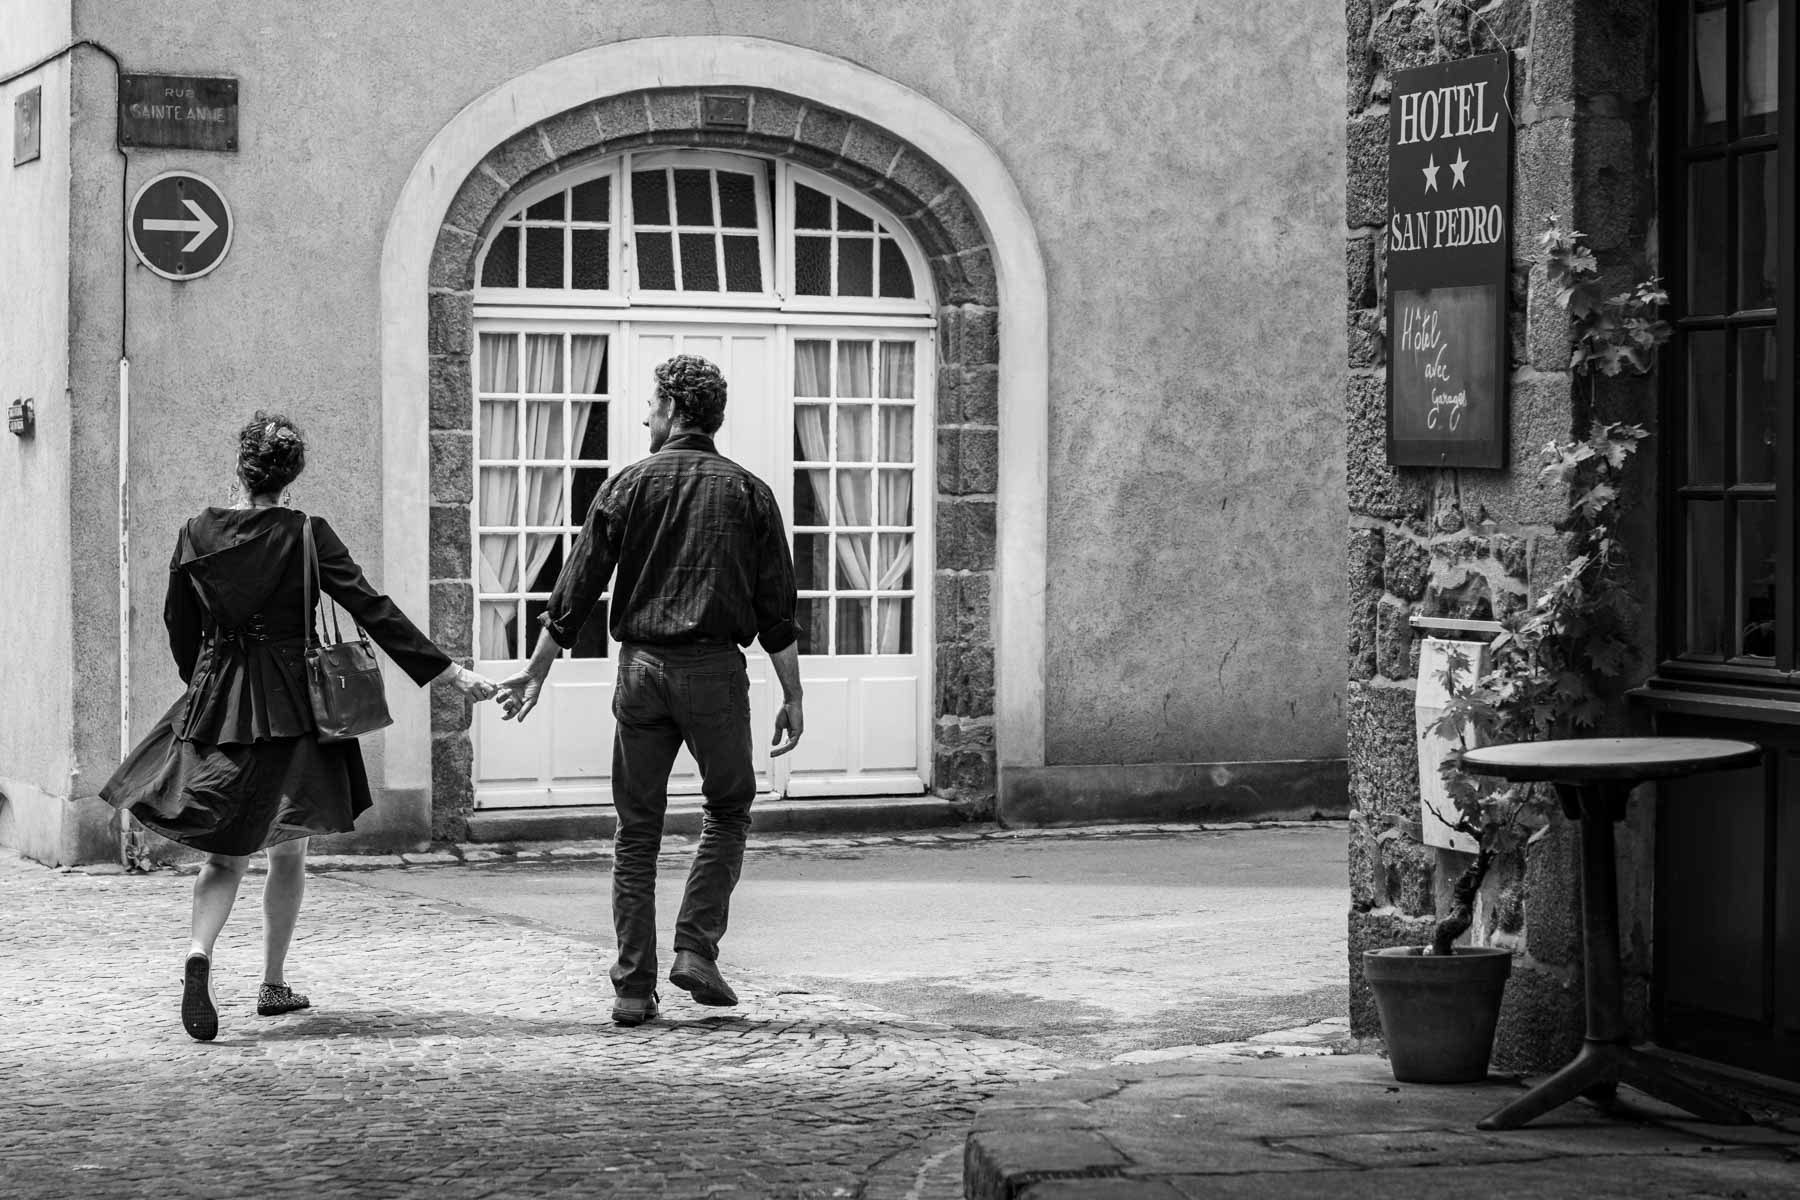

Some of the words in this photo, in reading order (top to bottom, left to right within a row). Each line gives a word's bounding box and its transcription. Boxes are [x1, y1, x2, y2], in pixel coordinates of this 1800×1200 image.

[130, 103, 181, 120] SAINTE
[1397, 81, 1499, 145] HOTEL
[1391, 210, 1430, 251] SAN
[1433, 204, 1502, 248] PEDRO
[1424, 343, 1450, 381] avec
